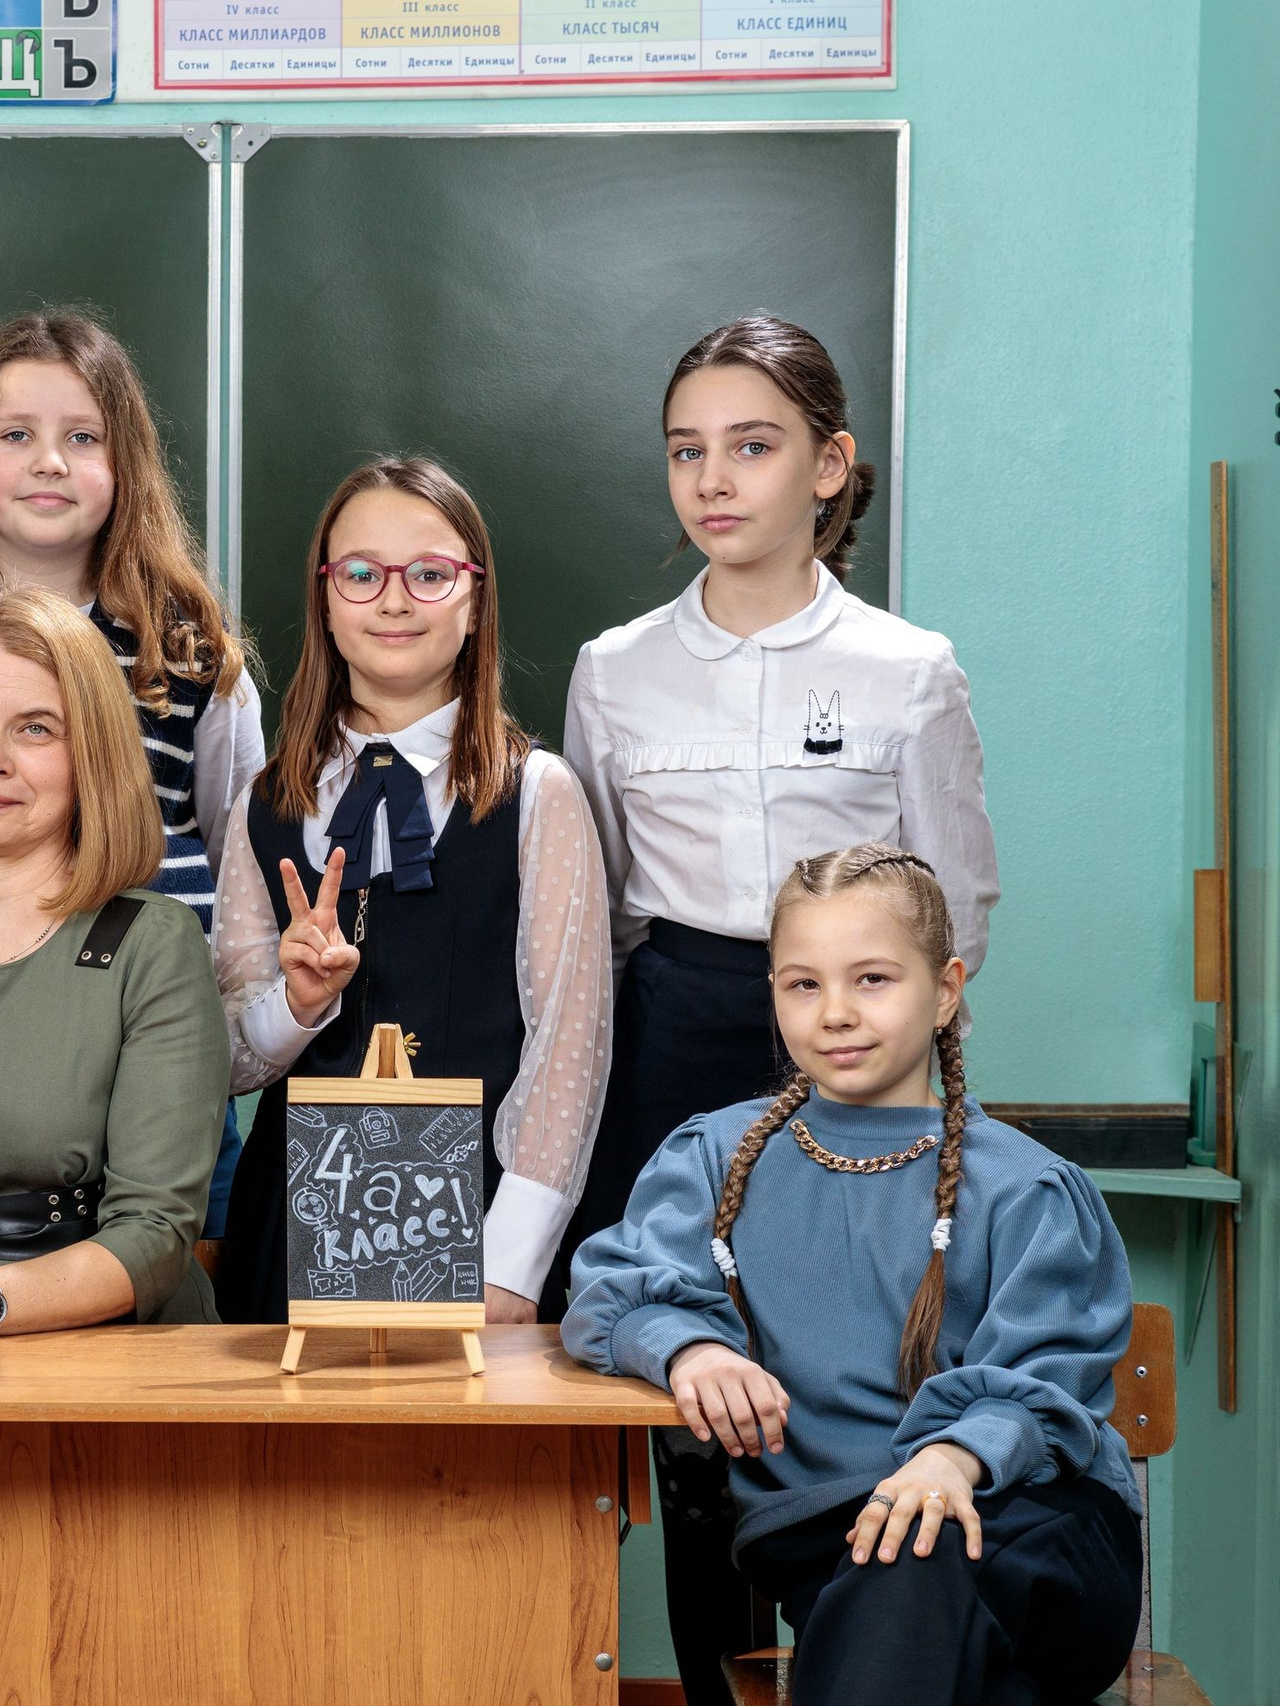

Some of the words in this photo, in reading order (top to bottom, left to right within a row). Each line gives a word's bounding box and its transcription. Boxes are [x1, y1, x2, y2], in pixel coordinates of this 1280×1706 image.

[403, 2, 418, 12] III
[425, 3, 459, 12] класс
[602, 0, 637, 8] класс
[226, 5, 239, 14] IV
[245, 6, 279, 14] класс
[562, 22, 607, 35] КЛАСС
[611, 21, 660, 34] ТЫСЯЧ
[737, 18, 782, 30] КЛАСС
[787, 16, 847, 31] ЕДИНИЦ
[179, 29, 223, 41] КЛАСС
[228, 28, 326, 42] МИЛЛИАРДОВ
[360, 27, 405, 39] КЛАСС
[410, 25, 501, 38] МИЛЛИОНОВ
[645, 52, 696, 62] Единицы
[715, 50, 747, 60] Сотни
[769, 49, 814, 59] Десятки
[826, 48, 877, 58] Единицы
[355, 58, 387, 68] Сотни
[408, 58, 453, 68] Десятки
[465, 56, 515, 67] Единицы
[535, 55, 567, 64] Сотни
[588, 53, 633, 64] Десятки
[178, 60, 209, 70] Сотни
[230, 60, 275, 70] Десятки
[287, 59, 337, 69] Единицы
